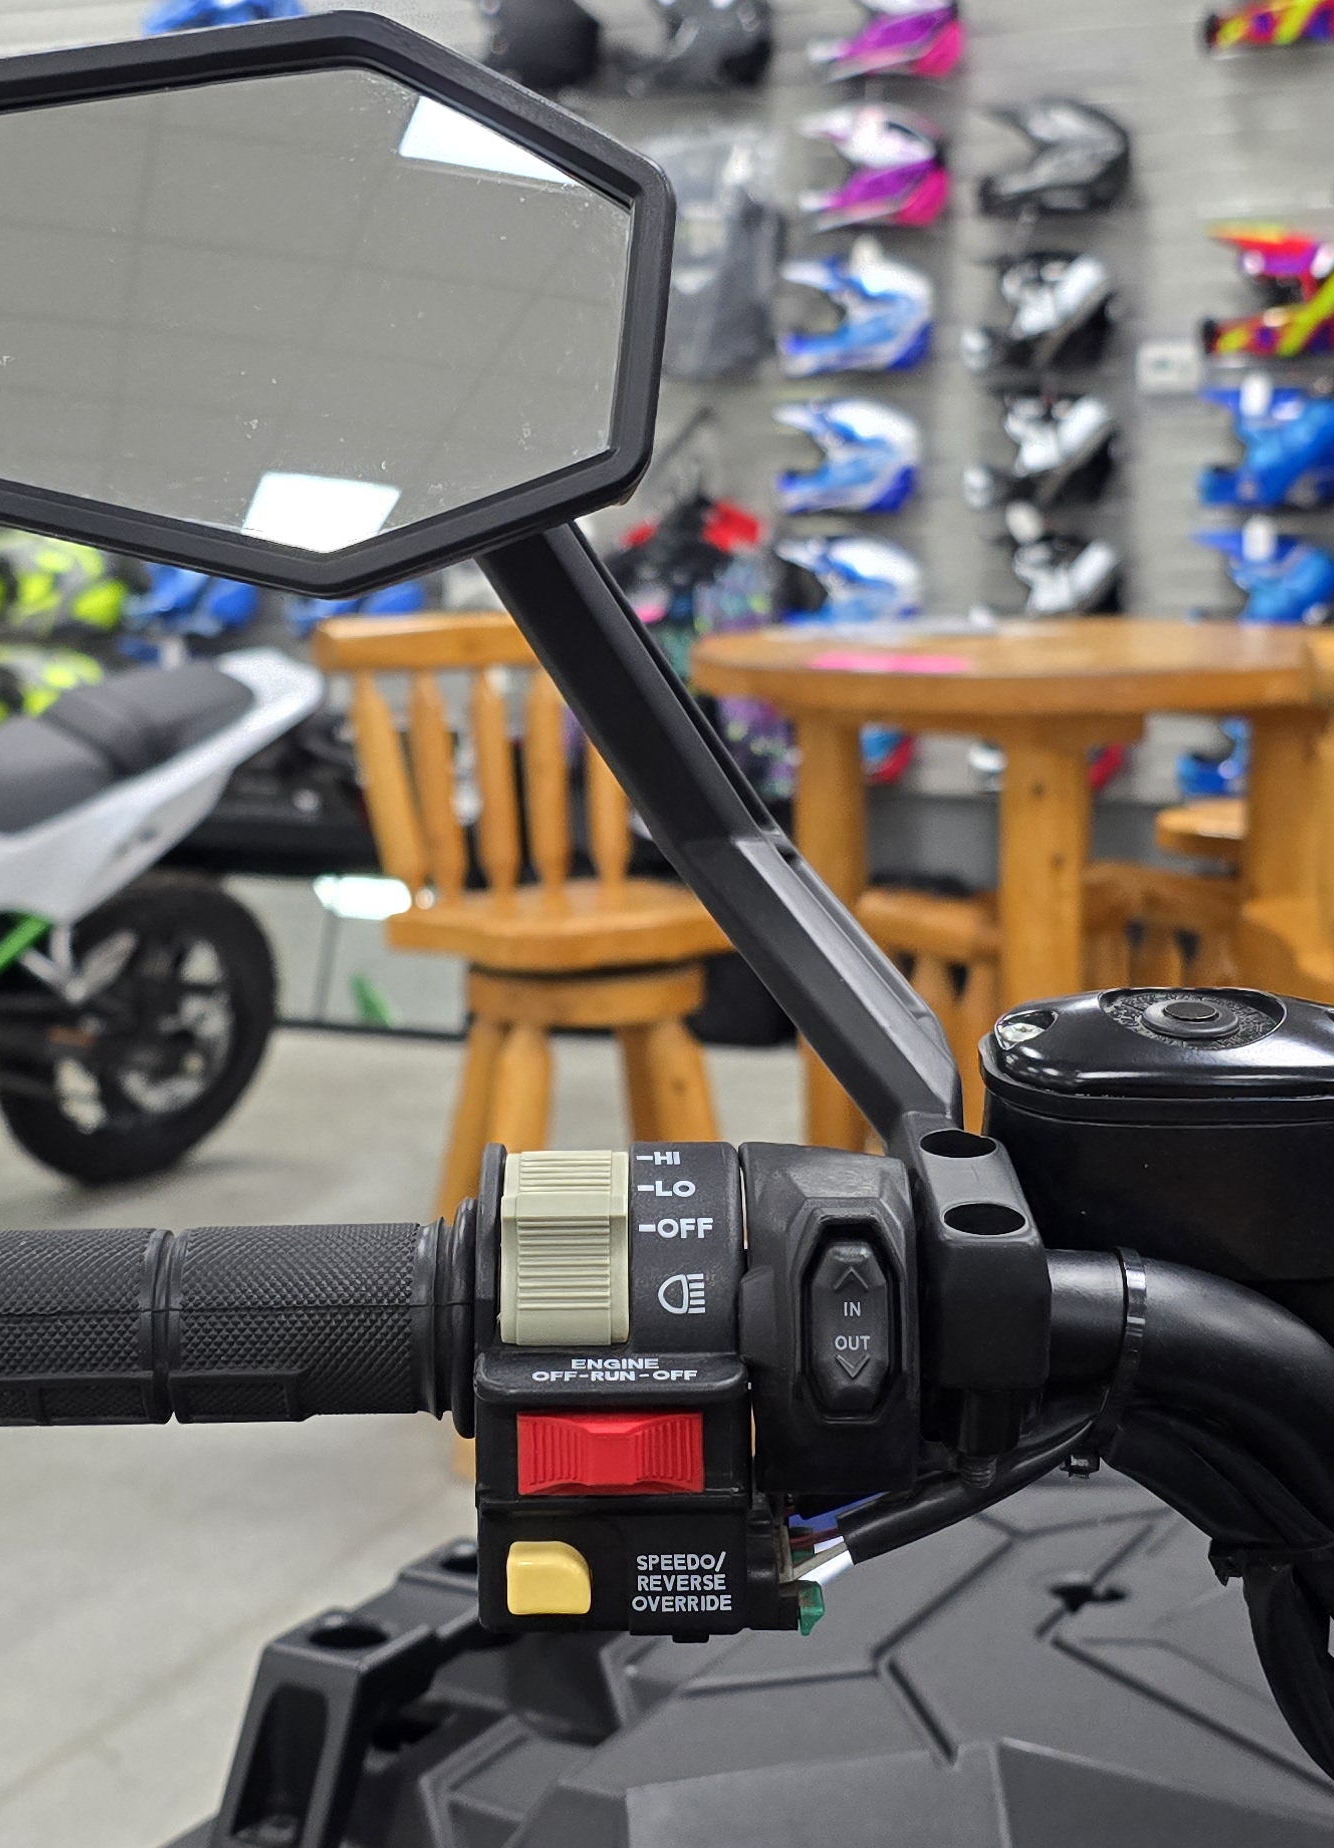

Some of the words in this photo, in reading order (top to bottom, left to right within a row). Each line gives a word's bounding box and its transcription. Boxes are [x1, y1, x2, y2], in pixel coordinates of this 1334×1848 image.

[843, 1301, 861, 1317] IN
[834, 1334, 871, 1351] OUT
[570, 1357, 660, 1370] ENGINE
[636, 1550, 727, 1573] SPEEDO/
[637, 1573, 727, 1592] REVERSE
[631, 1594, 733, 1613] OVERRIDE
